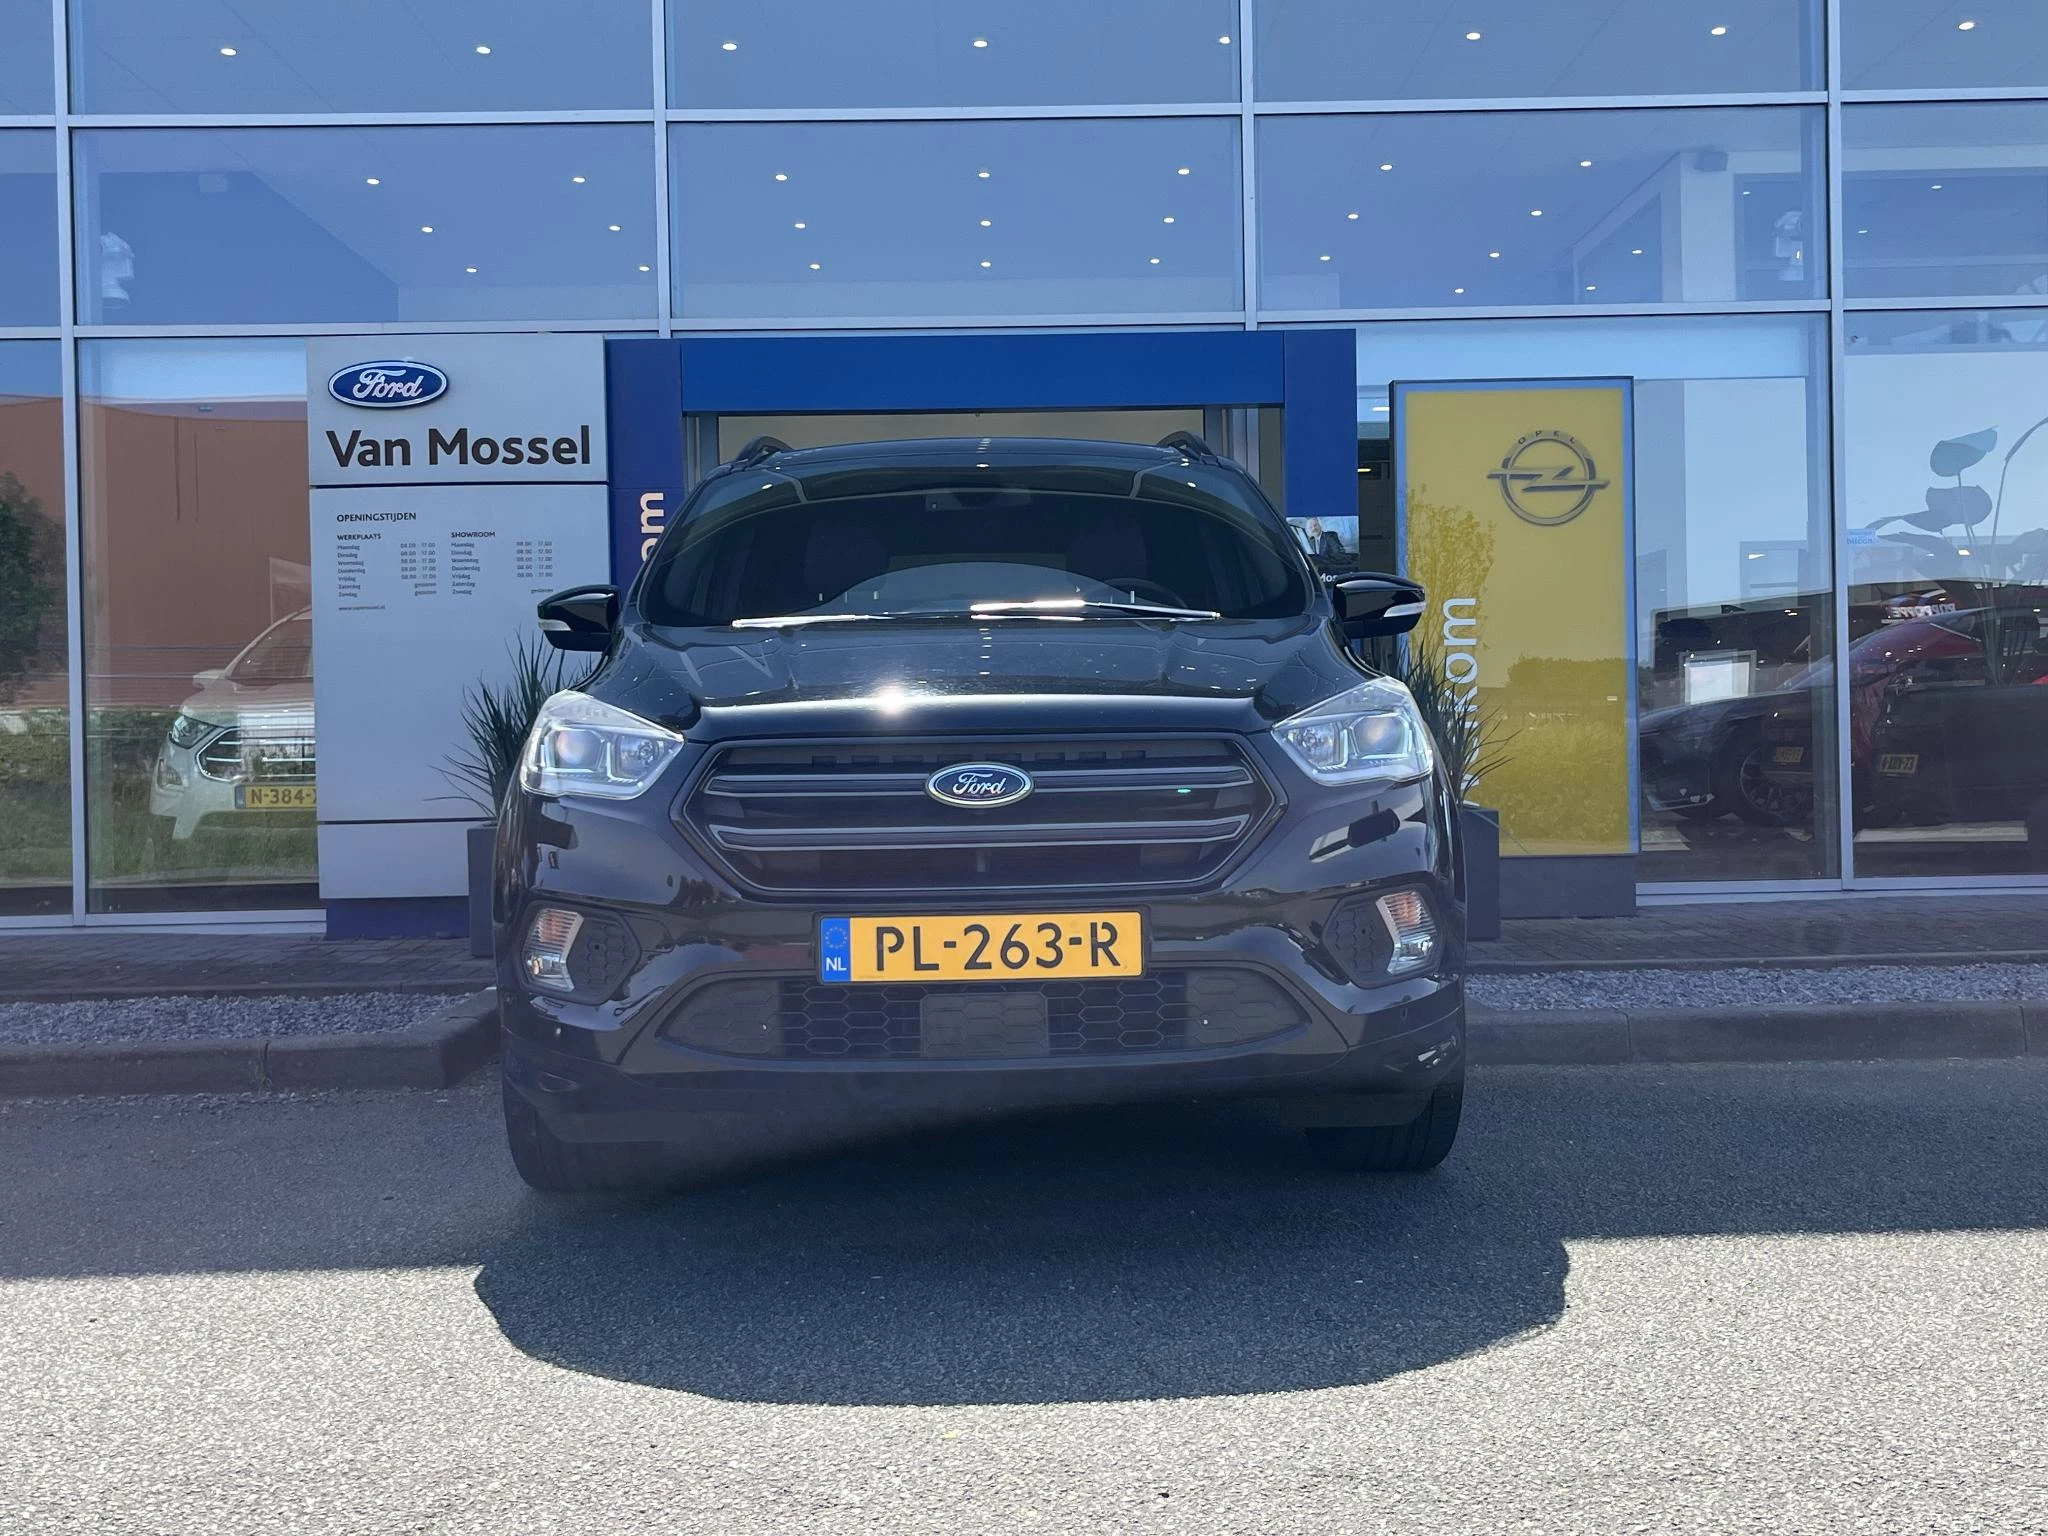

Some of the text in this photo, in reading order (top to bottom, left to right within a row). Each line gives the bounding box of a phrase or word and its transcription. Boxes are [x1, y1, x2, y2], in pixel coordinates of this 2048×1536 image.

[353, 369, 424, 399] Ford
[1518, 430, 1577, 445] OPEL
[326, 425, 590, 467] Van Mossel
[336, 512, 417, 522] OPENINGSTIJDEN
[337, 533, 382, 541] WERKPLAATS
[953, 772, 1007, 795] Ford
[251, 788, 316, 804] N-384-
[876, 921, 1121, 972] PL-263-R
[825, 957, 847, 971] NL
